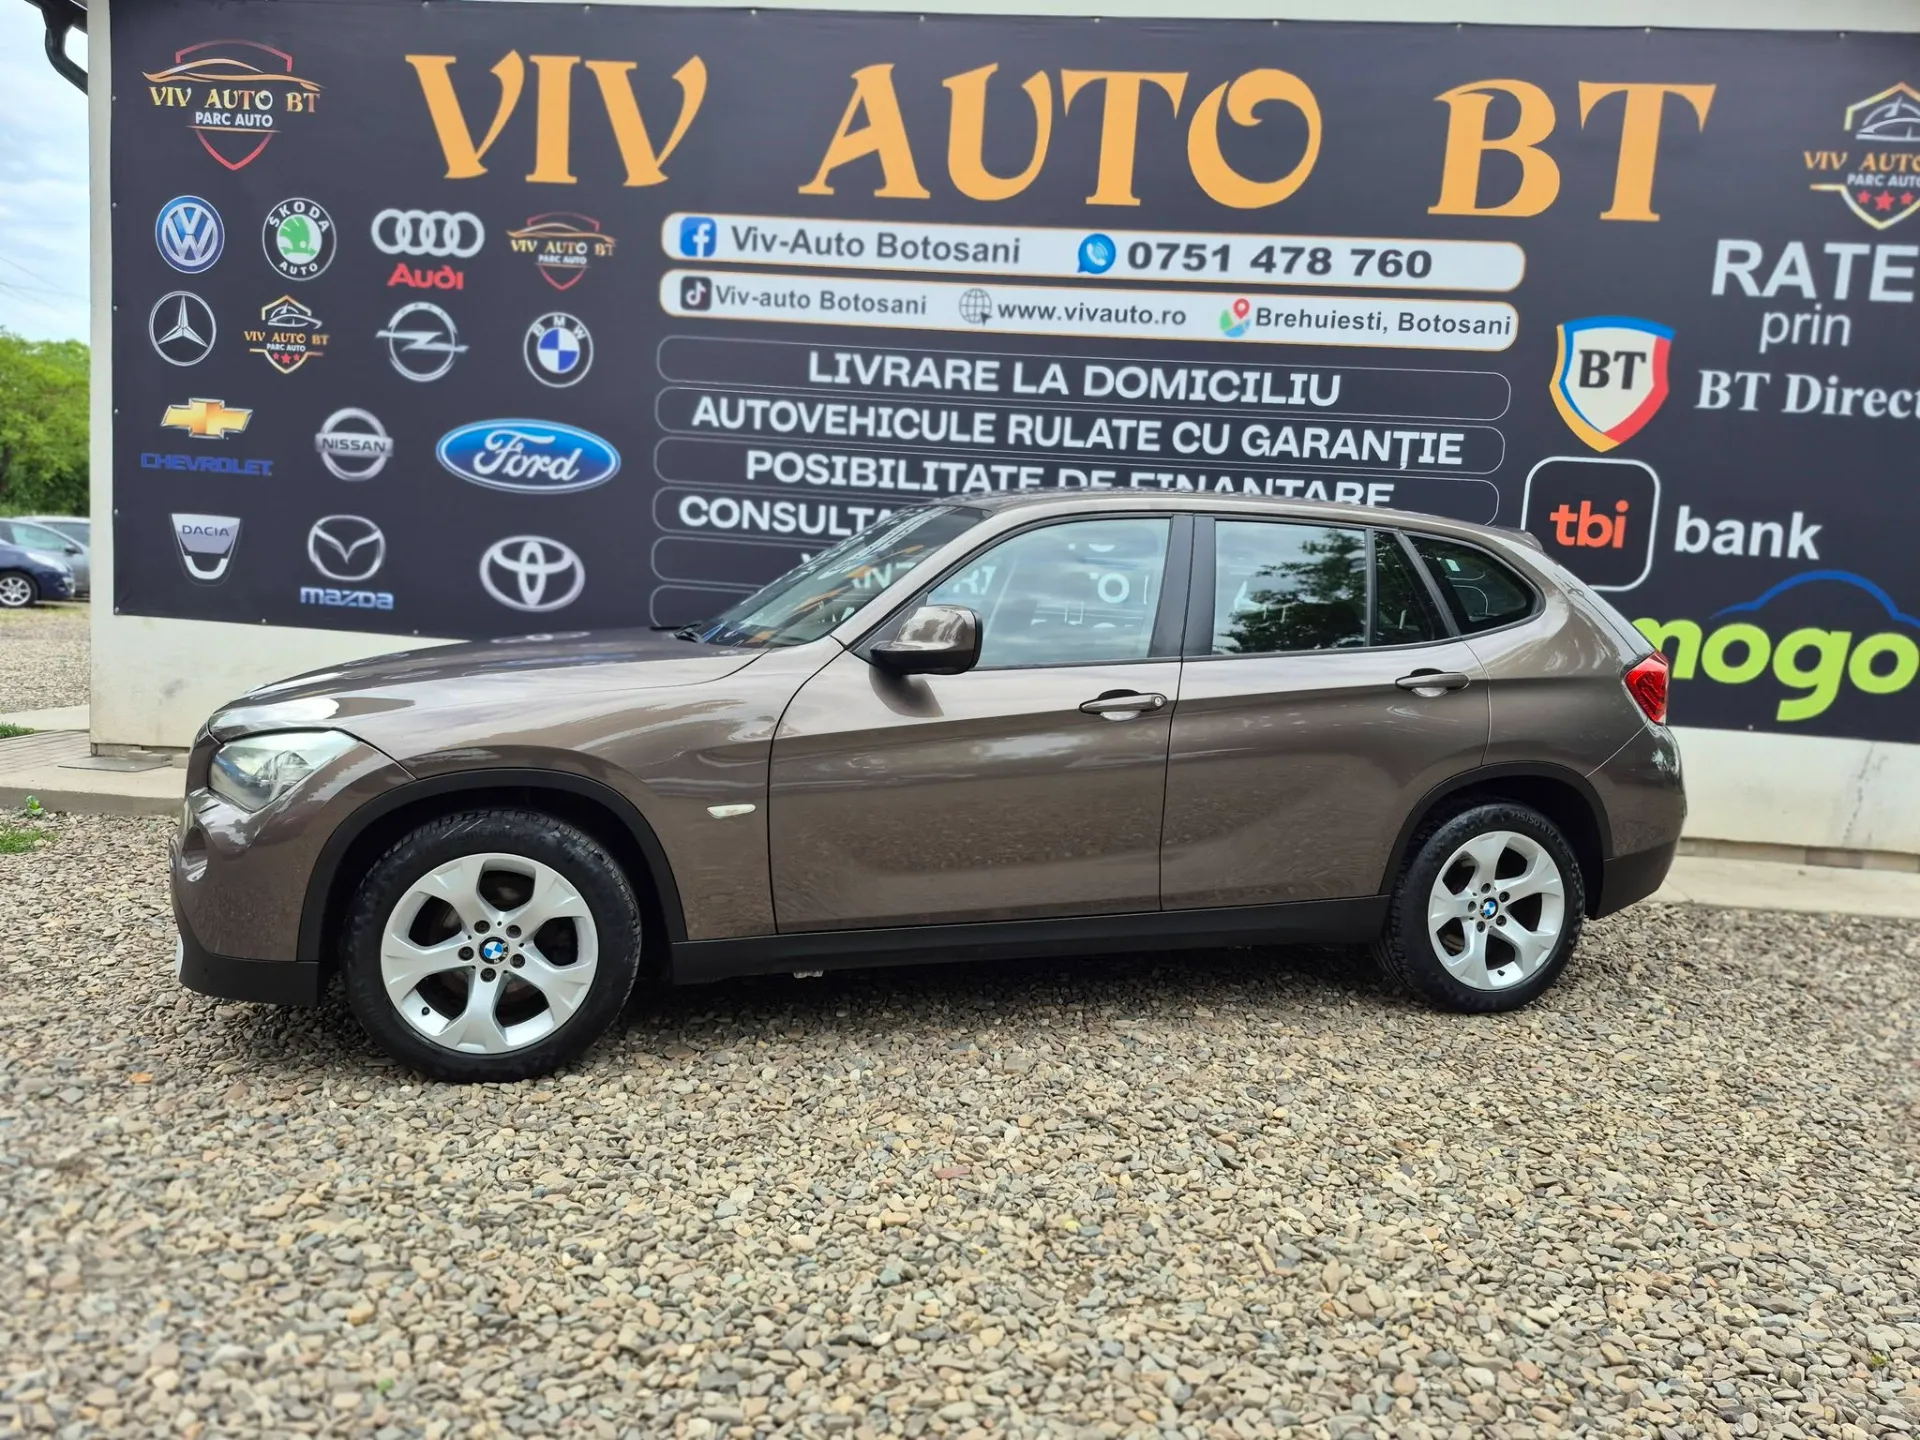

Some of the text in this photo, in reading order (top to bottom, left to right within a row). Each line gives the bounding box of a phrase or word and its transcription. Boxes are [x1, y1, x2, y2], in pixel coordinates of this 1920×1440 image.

[149, 86, 320, 113] VIV AUTO BT
[195, 111, 274, 128] PARC AUTO
[405, 49, 1717, 222] VIV AUTO BT
[1803, 151, 1848, 170] VIV
[1847, 173, 1884, 187] PARC
[269, 200, 330, 233] SKODA
[511, 239, 614, 257] VIV AUTO BT
[731, 225, 1021, 264] Viv-Auto Botosani
[279, 260, 318, 276] AUTO
[538, 254, 588, 265] PARC AUTO
[1127, 241, 1433, 279] 0751 478 760
[1711, 238, 1920, 303] RATE
[387, 262, 465, 291] Audi
[715, 285, 927, 316] Viv-auto Botosani
[998, 301, 1187, 326] www.vivauto.ro
[531, 315, 588, 341] BMW
[1256, 307, 1512, 336] Brehuiesti, Botosani
[1758, 302, 1852, 353] prin
[244, 330, 330, 345] VIV AUTO BT
[266, 343, 306, 352] PARC AUTO
[808, 351, 1341, 407] LIVRARE LA DOMICILIU
[1578, 349, 1646, 390] BT
[1694, 369, 1771, 411] BT
[692, 396, 996, 444] AUTOVEHICULE
[1008, 414, 1162, 452] RULATE
[1172, 421, 1231, 455] CU
[322, 437, 386, 453] NISSAN
[473, 429, 583, 481] Ford
[141, 452, 274, 476] CHEVROLET
[746, 450, 1044, 493] POSIBILITATE
[181, 524, 230, 537] DACIA
[1549, 500, 1822, 560] tbi bank
[300, 586, 394, 610] mazda
